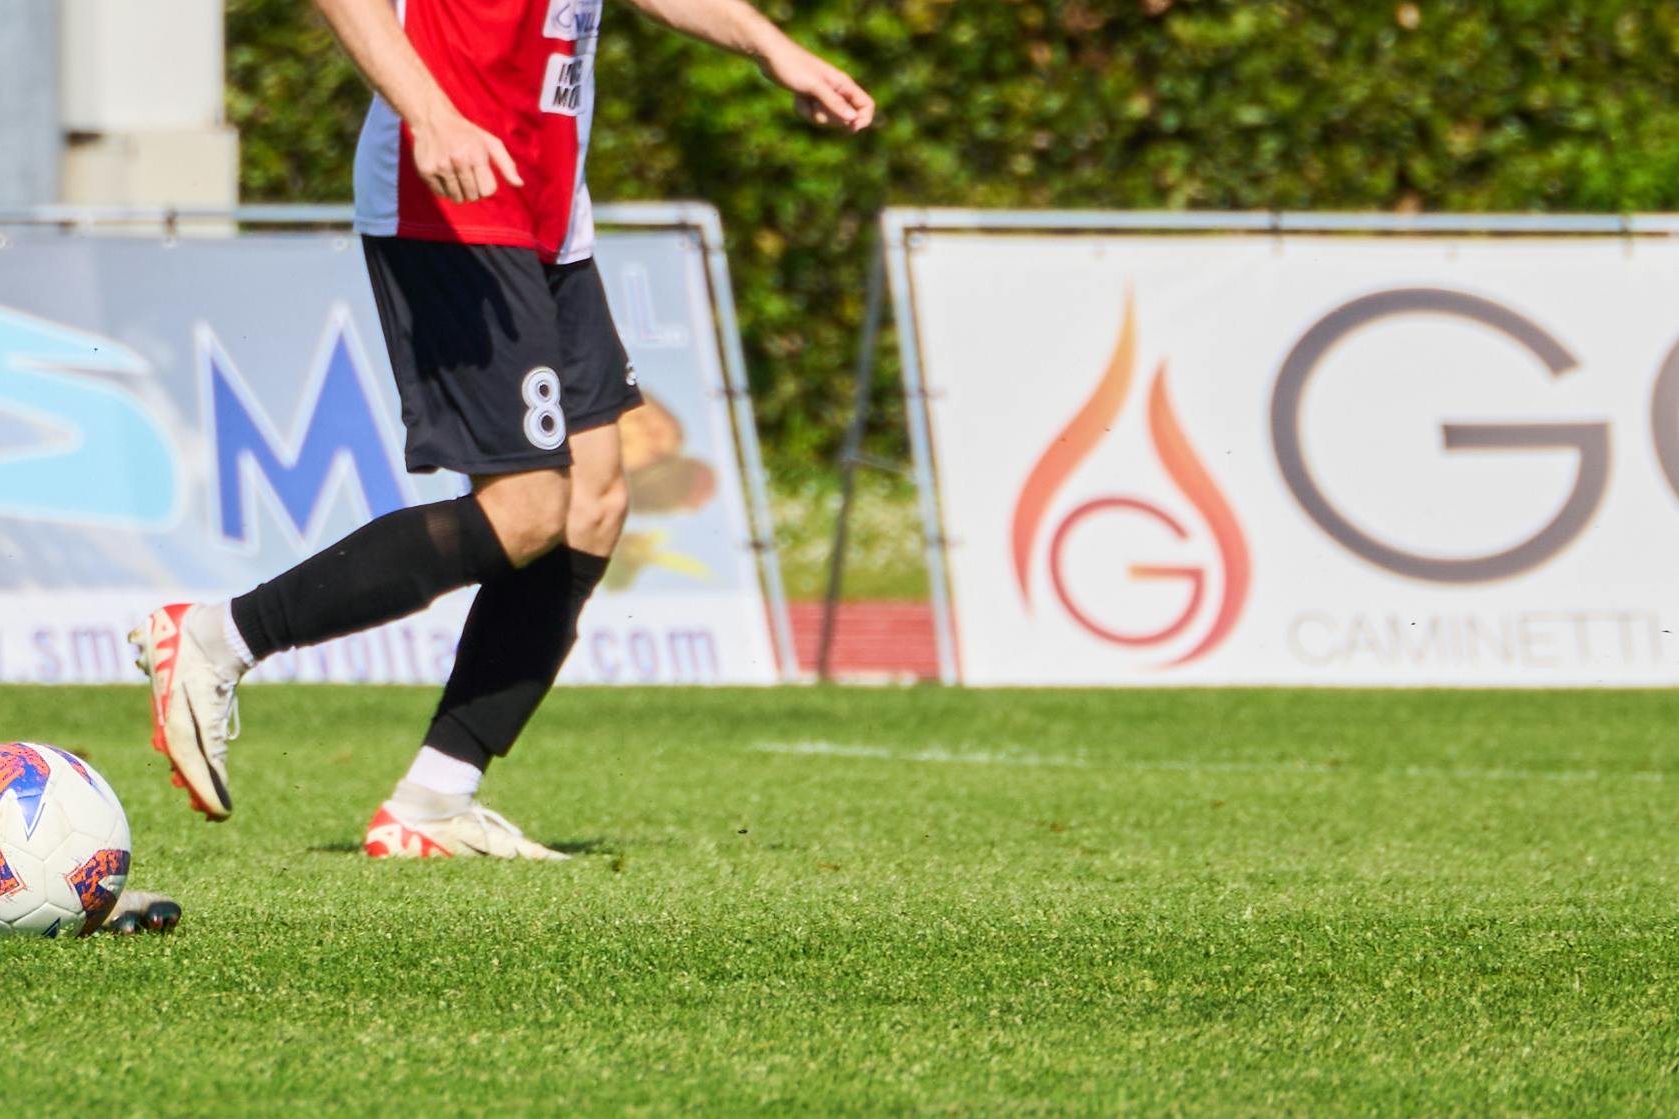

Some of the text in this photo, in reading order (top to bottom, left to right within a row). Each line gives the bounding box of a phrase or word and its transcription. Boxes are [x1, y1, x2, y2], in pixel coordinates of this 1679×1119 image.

[522, 366, 566, 450] 8
[1269, 286, 1679, 587] G
[1050, 498, 1204, 646] G
[1287, 608, 1664, 669] CAMINETTI
